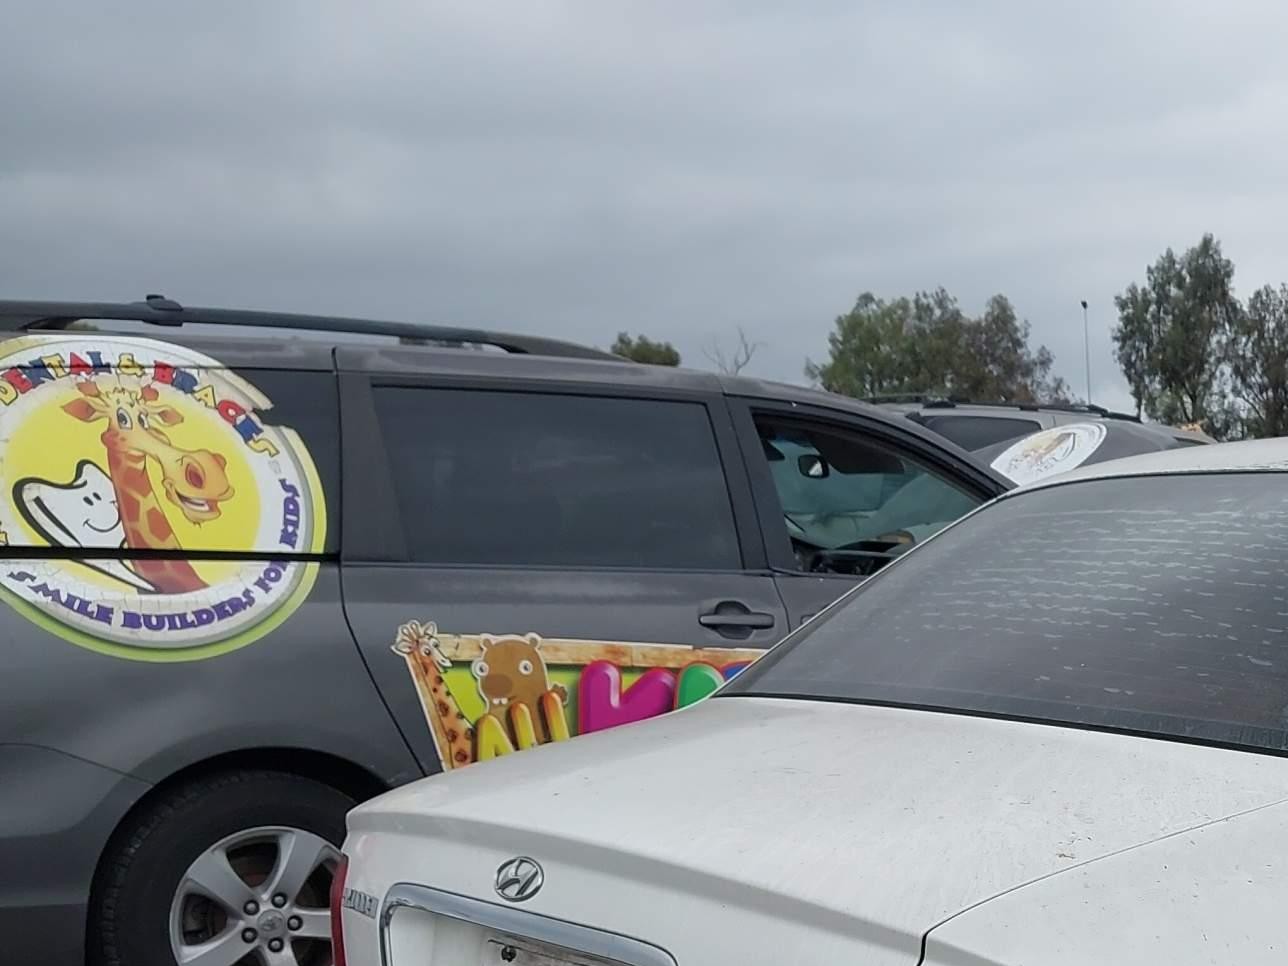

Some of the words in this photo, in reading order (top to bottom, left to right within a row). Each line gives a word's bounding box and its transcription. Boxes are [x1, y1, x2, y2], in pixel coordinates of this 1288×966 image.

[117, 352, 146, 377] &
[152, 360, 280, 458] BRACES
[6, 571, 114, 627] SMILE
[120, 588, 256, 631] BUILDERS
[279, 478, 300, 549] KIDS
